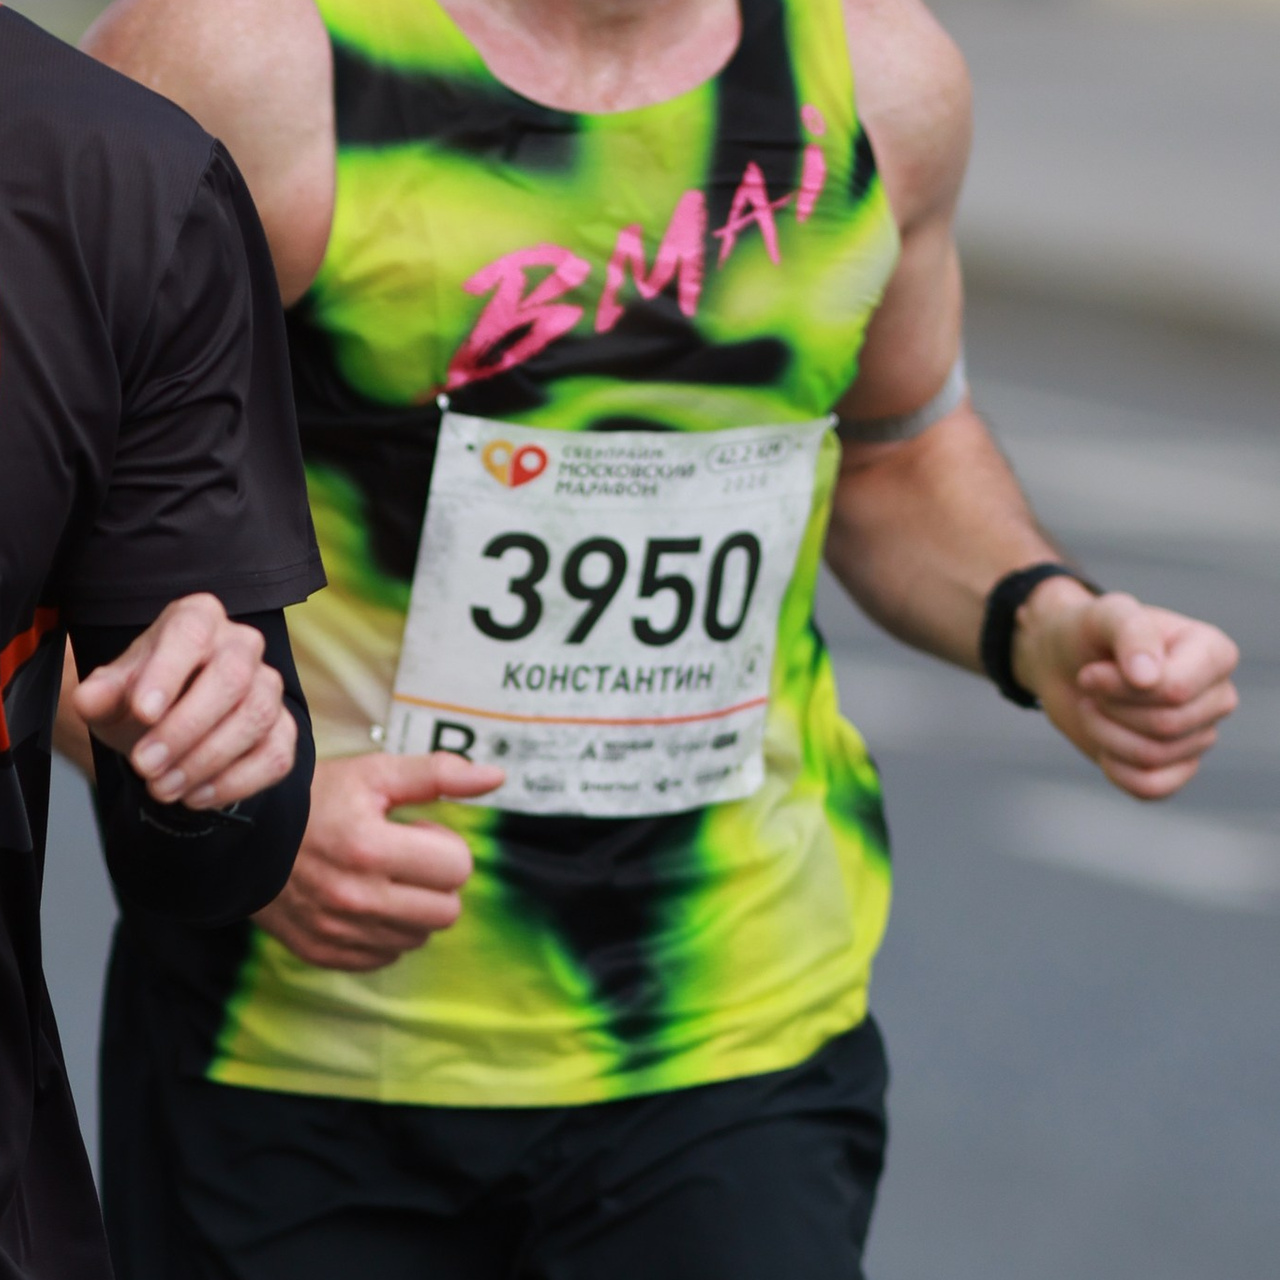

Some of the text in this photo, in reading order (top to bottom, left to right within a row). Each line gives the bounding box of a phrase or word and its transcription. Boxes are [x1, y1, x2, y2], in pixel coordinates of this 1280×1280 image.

[555, 479, 658, 497] МАРАФОН
[469, 530, 763, 647] 3950
[500, 662, 715, 694] КОНСТАНТИН
